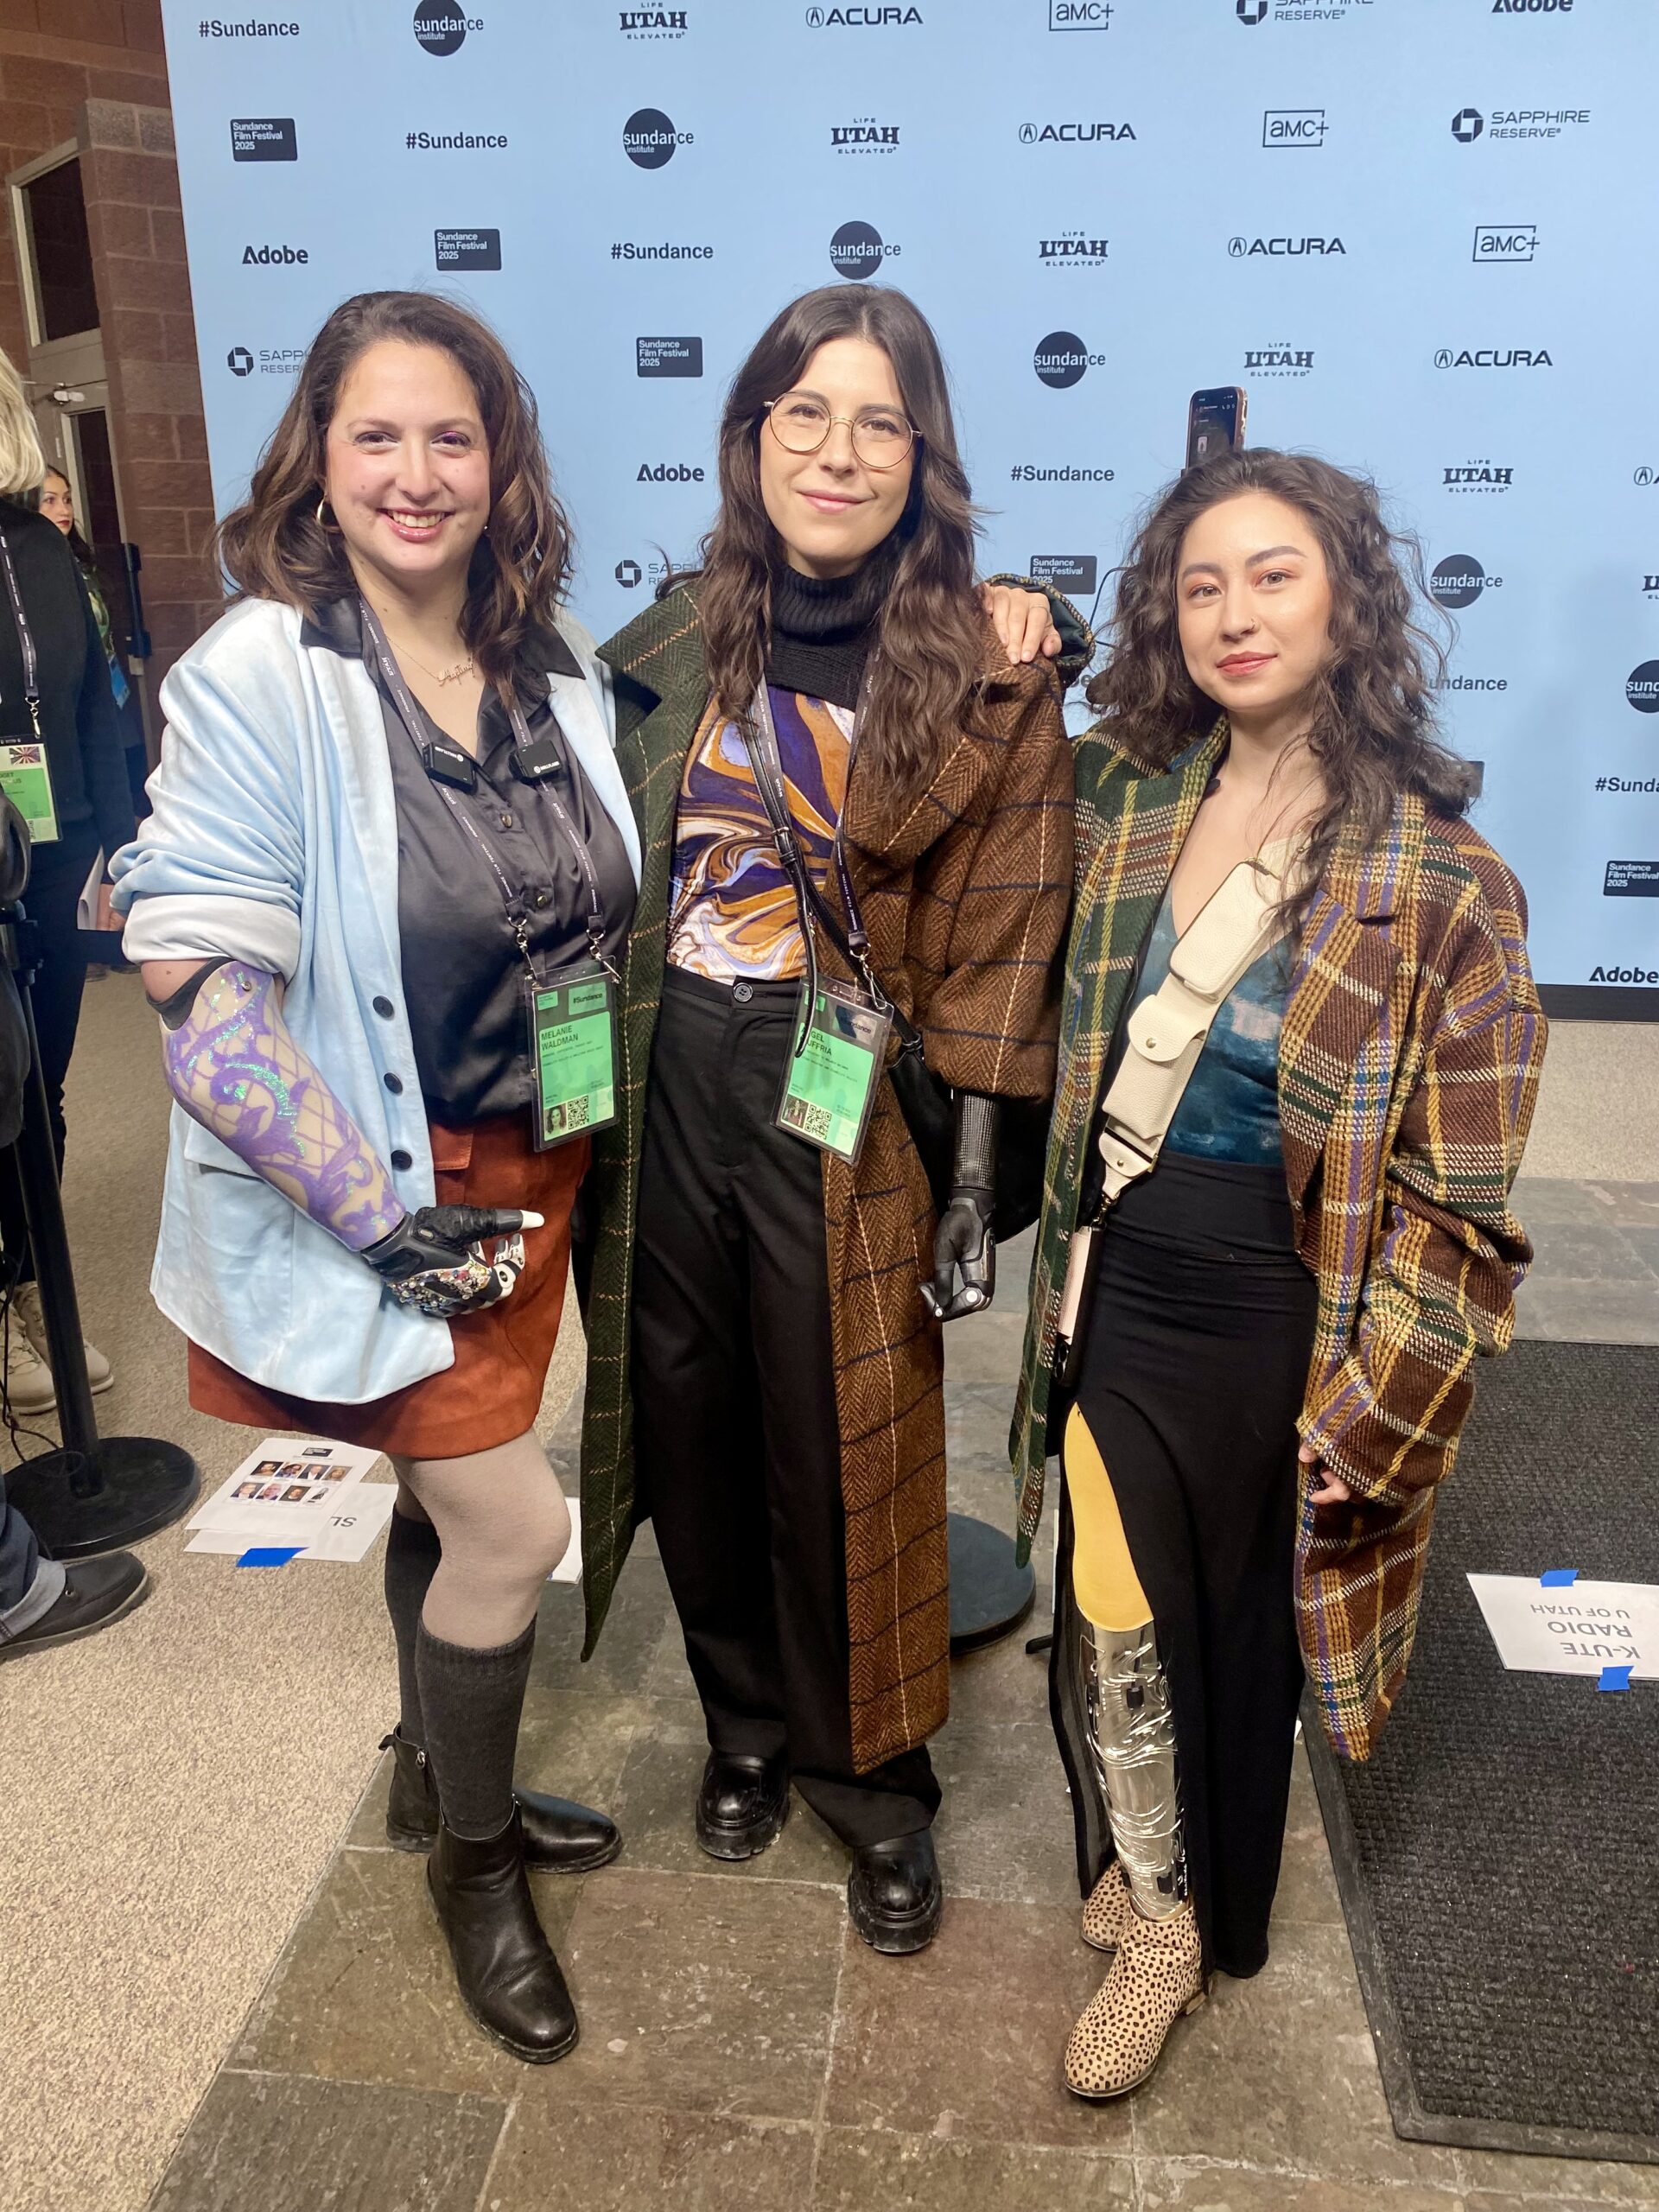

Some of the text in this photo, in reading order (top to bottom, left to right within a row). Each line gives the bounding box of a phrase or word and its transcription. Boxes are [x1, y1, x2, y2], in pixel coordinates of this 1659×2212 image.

[620, 11, 688, 30] UTAH
[823, 7, 923, 26] ACURA
[200, 19, 299, 37] #Sundance
[413, 16, 484, 33] sundance
[417, 32, 446, 41] institute
[1491, 111, 1591, 124] SAPPHIRE
[232, 122, 273, 130] Sundance
[1039, 124, 1136, 142] ACURA
[234, 131, 283, 140] Film Festival
[406, 132, 507, 149] #Sundance
[623, 129, 694, 146] sundance
[831, 127, 899, 145] UTAH
[235, 141, 255, 150] 2025
[626, 145, 655, 154] institute
[437, 232, 478, 241] Sundance
[438, 241, 487, 251] Film Festival
[611, 243, 713, 259] #Sundance
[830, 241, 901, 258] sundance
[1039, 240, 1109, 258] UTAH
[1246, 238, 1346, 255] ACURA
[242, 245, 308, 264] Adobe
[438, 251, 459, 260] 2025
[833, 256, 861, 264] institute
[639, 340, 680, 349] Sundance
[259, 350, 304, 361] SAPP
[639, 349, 690, 358] Film Festival
[1034, 352, 1106, 366] sundance
[1244, 352, 1314, 368] UTAH
[1452, 350, 1553, 366] ACURA
[639, 358, 660, 367] 2025
[1037, 365, 1065, 374] institute
[637, 463, 704, 481] Adobe
[1011, 466, 1115, 481] #Sundance
[1443, 468, 1514, 485] UTAH
[1431, 574, 1503, 588] sundance
[1429, 675, 1507, 690] undance
[1609, 863, 1651, 872] Sundance
[1588, 966, 1659, 983] Adobe
[541, 1025, 572, 1040] MELANIE
[542, 1034, 579, 1051] WALDMAN
[1530, 1604, 1630, 1618] U OF UTAH
[1548, 1622, 1633, 1637] RADIO
[1560, 1643, 1641, 1659] K-UTE
